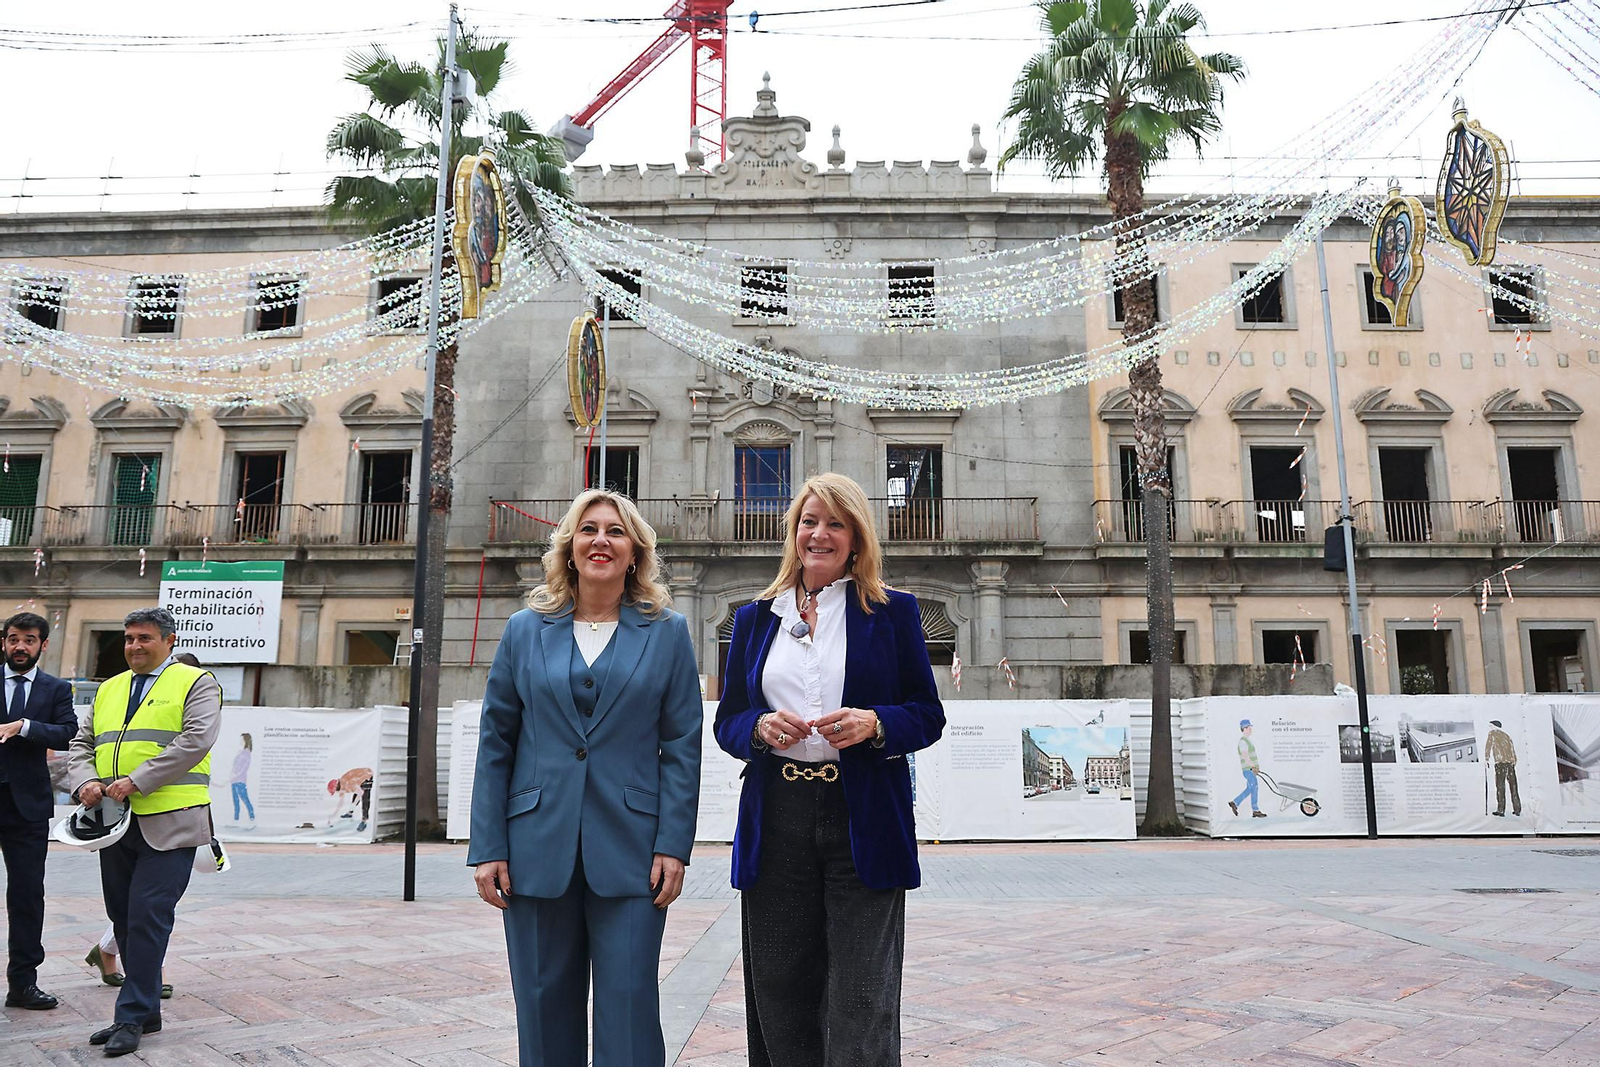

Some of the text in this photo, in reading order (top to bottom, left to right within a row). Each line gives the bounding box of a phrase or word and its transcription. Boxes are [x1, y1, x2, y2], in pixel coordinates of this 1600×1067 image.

[168, 587, 253, 599] Terminación
[166, 603, 264, 615] Rehabilitación
[174, 619, 214, 631] dificio
[174, 636, 266, 648] dministrativo
